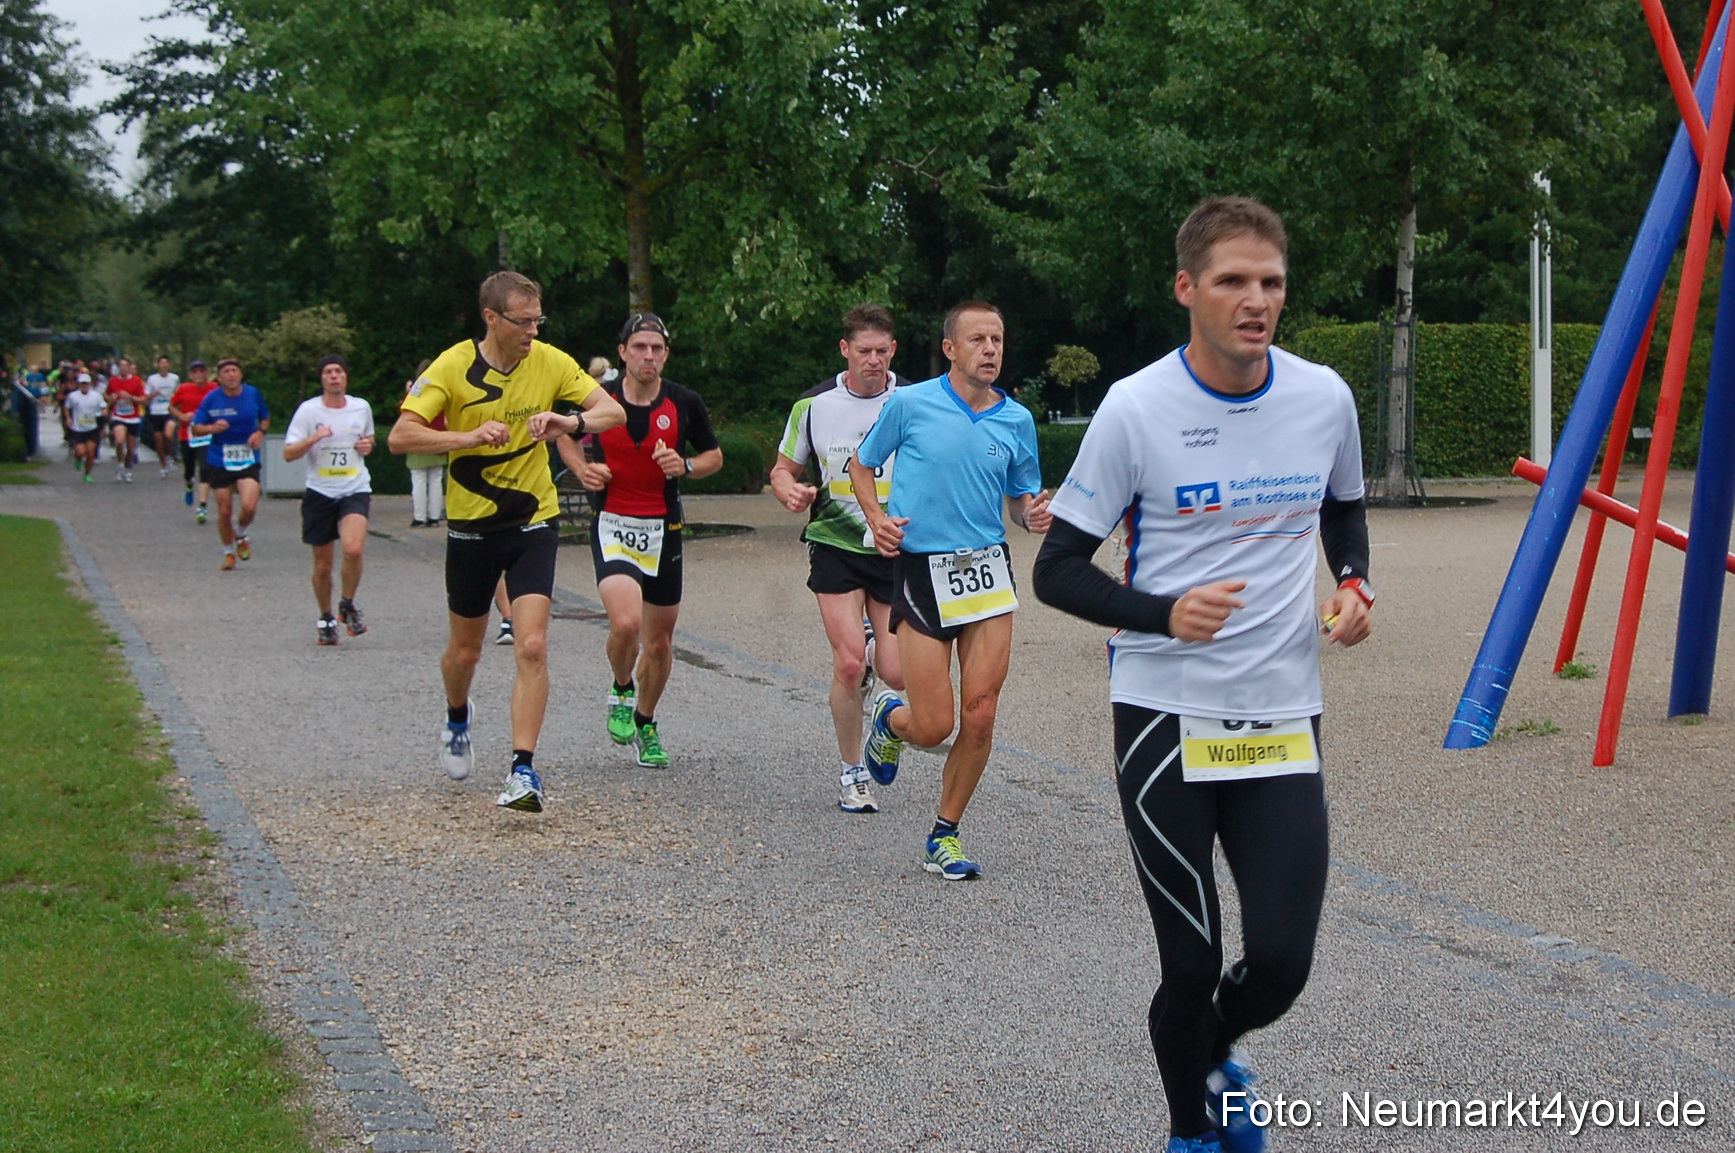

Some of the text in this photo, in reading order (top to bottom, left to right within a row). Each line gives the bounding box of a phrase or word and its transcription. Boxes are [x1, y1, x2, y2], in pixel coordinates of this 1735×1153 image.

[504, 405, 541, 418] Triathlon
[330, 452, 347, 466] 73
[828, 446, 851, 454] PARTL
[1228, 472, 1322, 491] Raiffeisenbank
[1230, 497, 1252, 508] am
[1255, 490, 1307, 506] Rothsee
[947, 564, 995, 596] 536
[1207, 743, 1289, 765] Wolfgang
